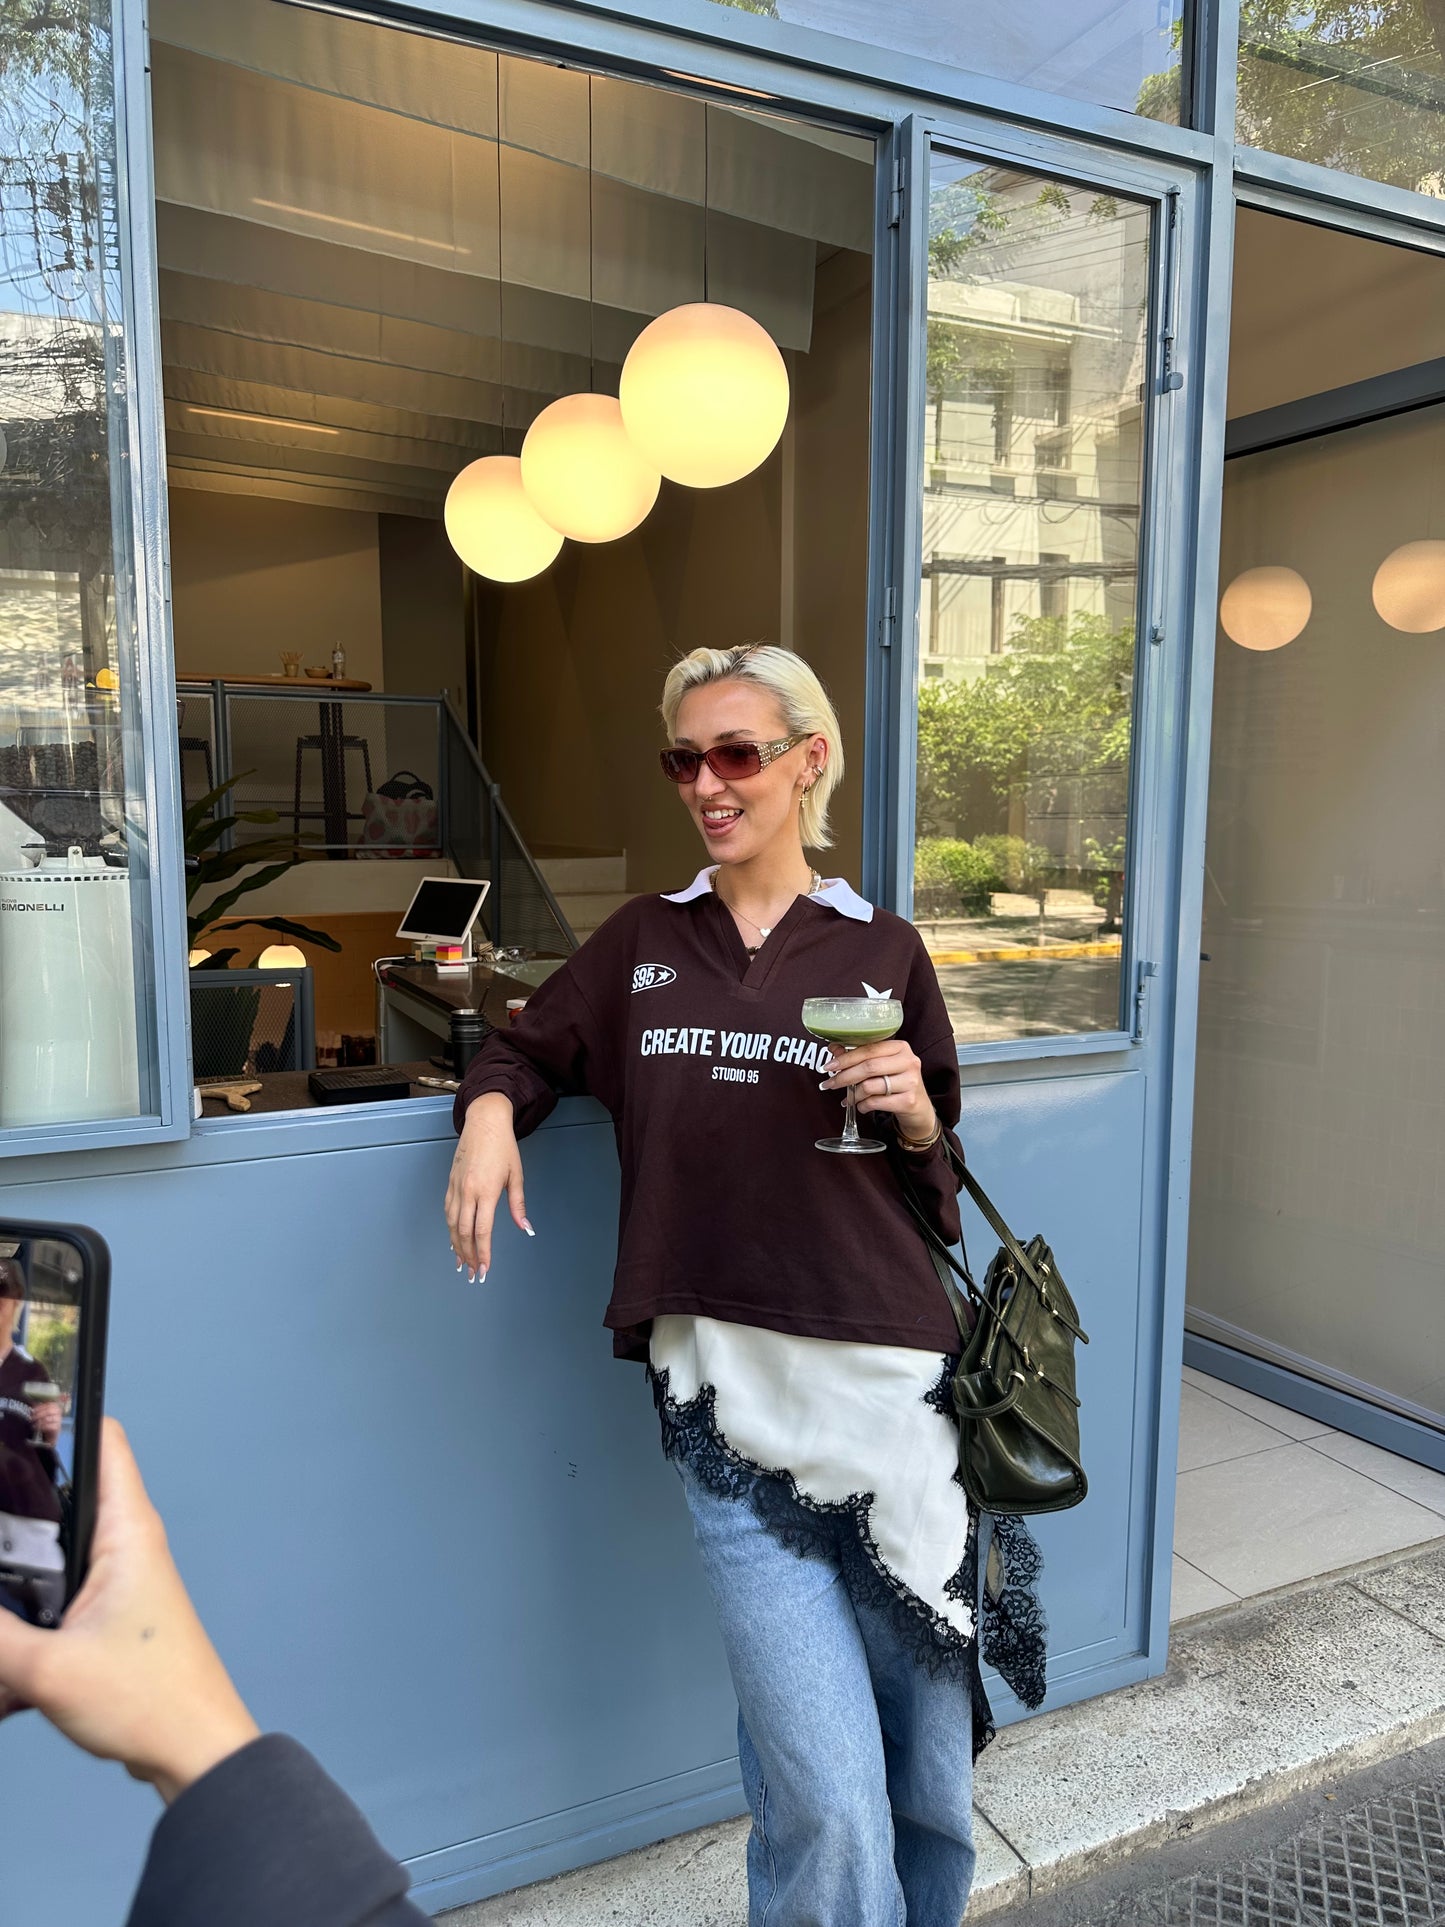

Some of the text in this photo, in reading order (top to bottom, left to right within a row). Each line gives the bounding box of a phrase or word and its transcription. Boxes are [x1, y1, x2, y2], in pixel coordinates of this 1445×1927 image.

[632, 966, 656, 990] S95
[640, 1027, 840, 1078] CREATE YOUR CHAO
[711, 1065, 760, 1084] STUDIO 95
